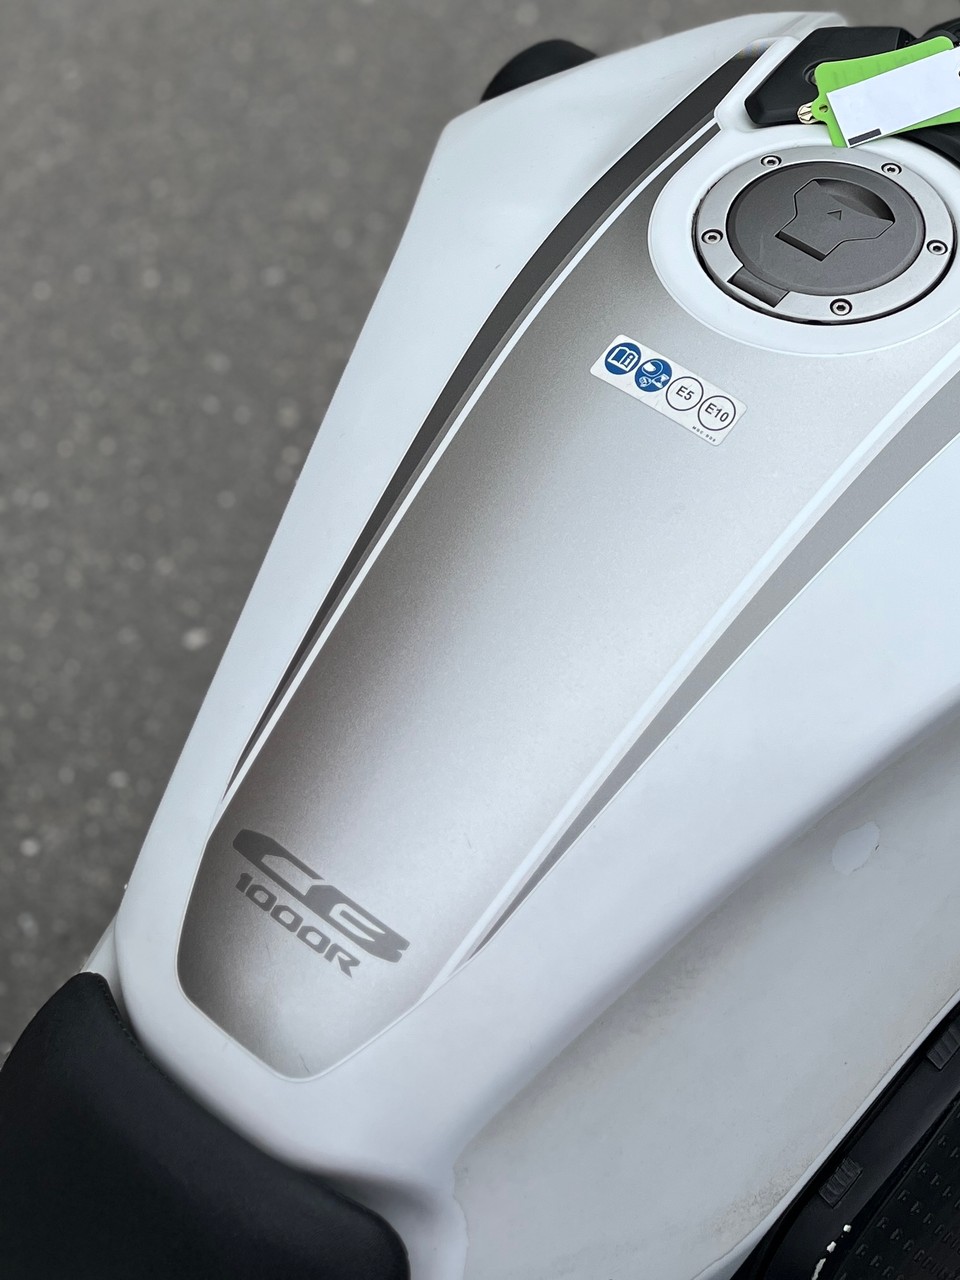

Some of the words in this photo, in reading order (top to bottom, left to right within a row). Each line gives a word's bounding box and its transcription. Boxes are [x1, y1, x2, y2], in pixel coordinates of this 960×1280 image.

[675, 385, 695, 401] E5
[704, 402, 730, 423] E10
[232, 828, 410, 963] CB
[235, 872, 361, 978] 1000R
